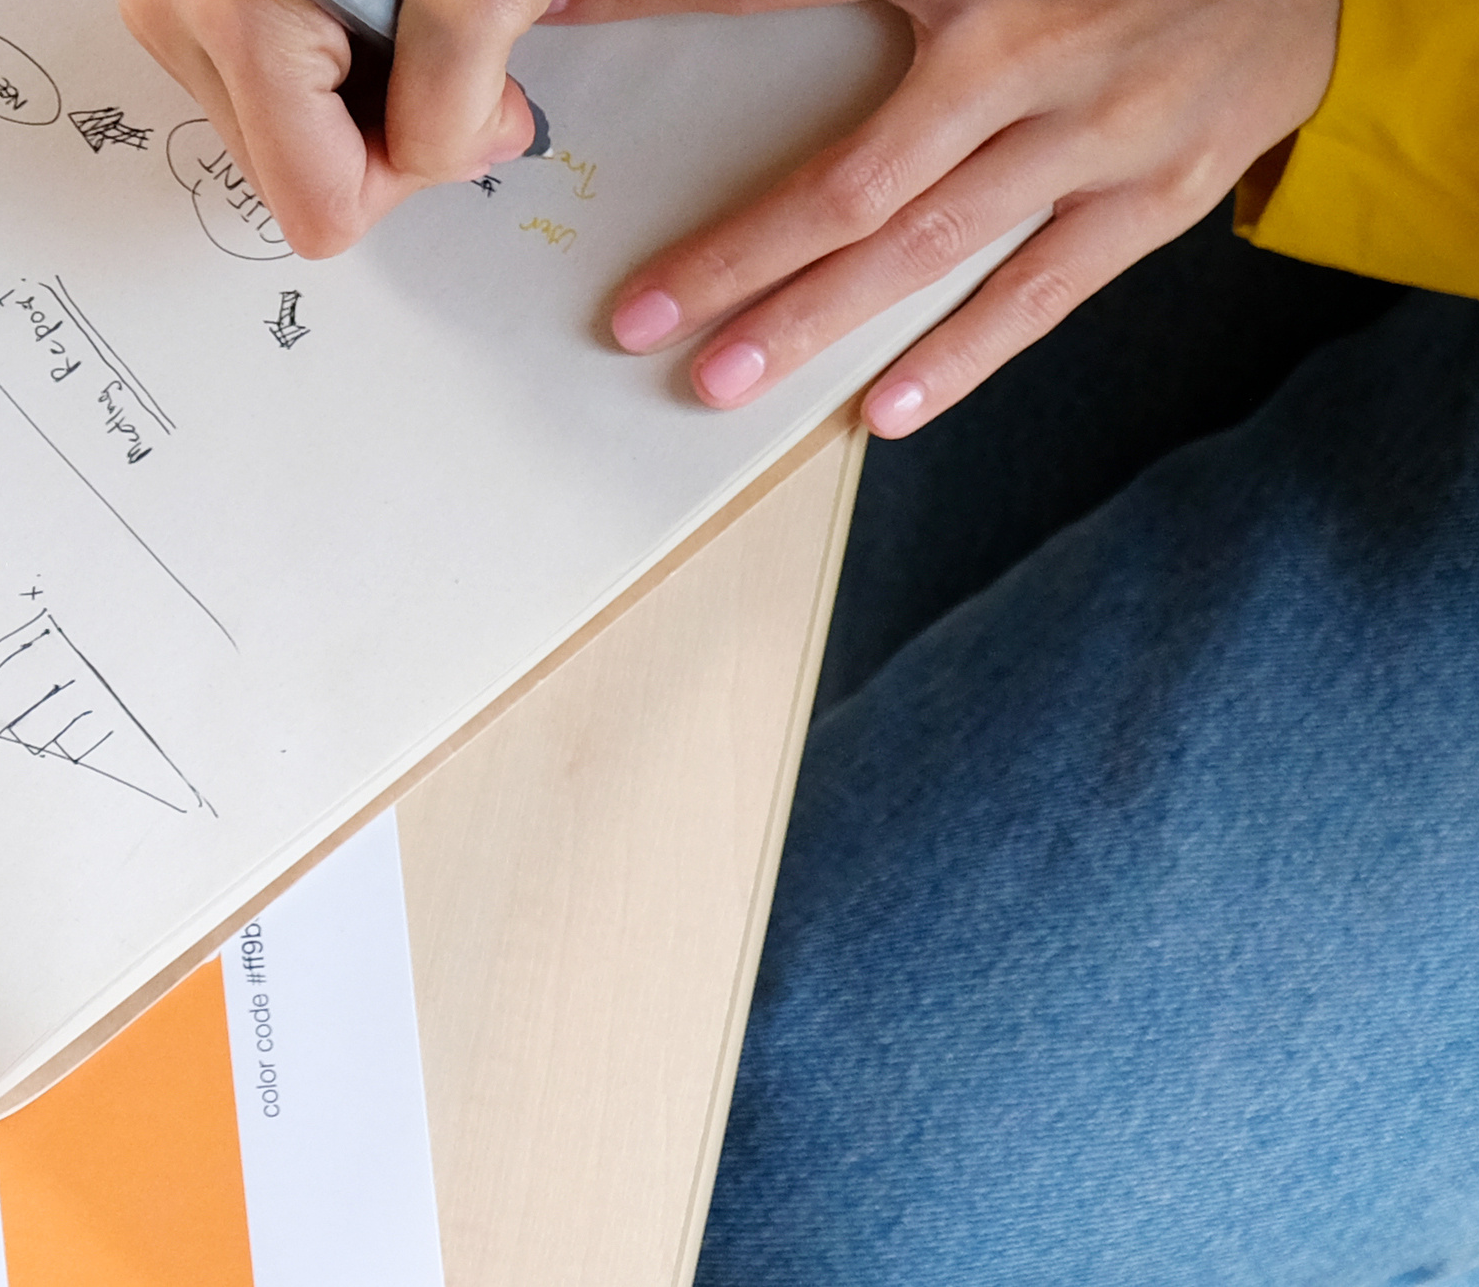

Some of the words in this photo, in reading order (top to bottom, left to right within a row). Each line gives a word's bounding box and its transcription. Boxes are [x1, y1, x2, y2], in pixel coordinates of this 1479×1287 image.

[241, 916, 267, 986] #ff9b
[249, 994, 274, 1053] code
[256, 1060, 280, 1118] color
